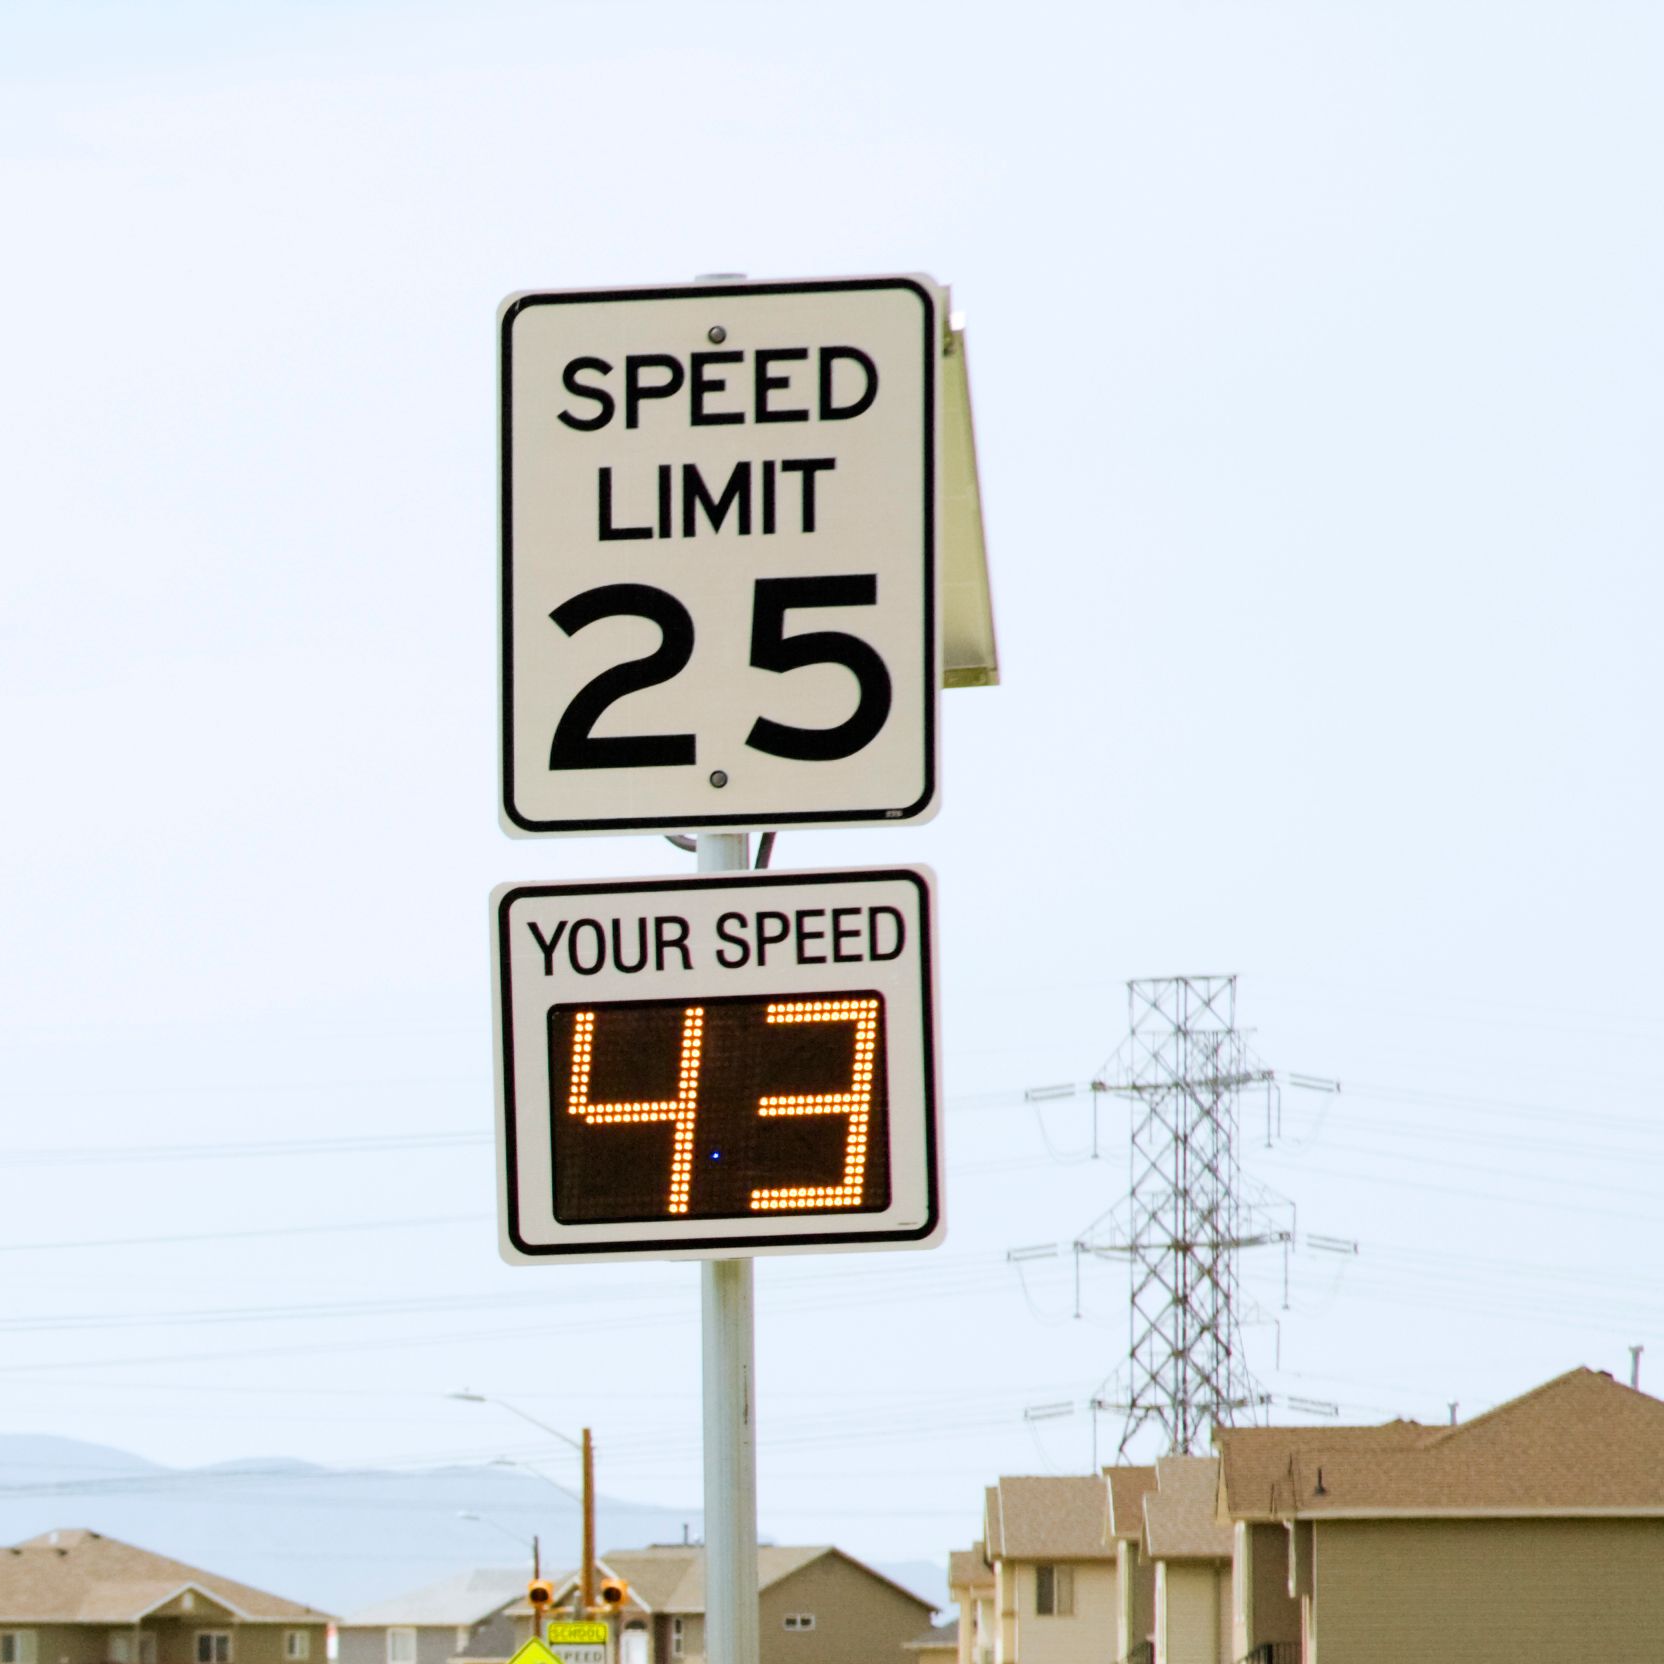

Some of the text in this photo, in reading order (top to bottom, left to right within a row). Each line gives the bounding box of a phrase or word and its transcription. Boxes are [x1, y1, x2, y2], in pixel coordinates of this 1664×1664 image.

[556, 345, 879, 432] SPEED
[598, 457, 836, 542] LIMIT
[548, 573, 893, 772] 25
[526, 905, 906, 977] YOUR SPEED
[568, 998, 879, 1215] 43
[552, 1626, 604, 1640] SCHOOL
